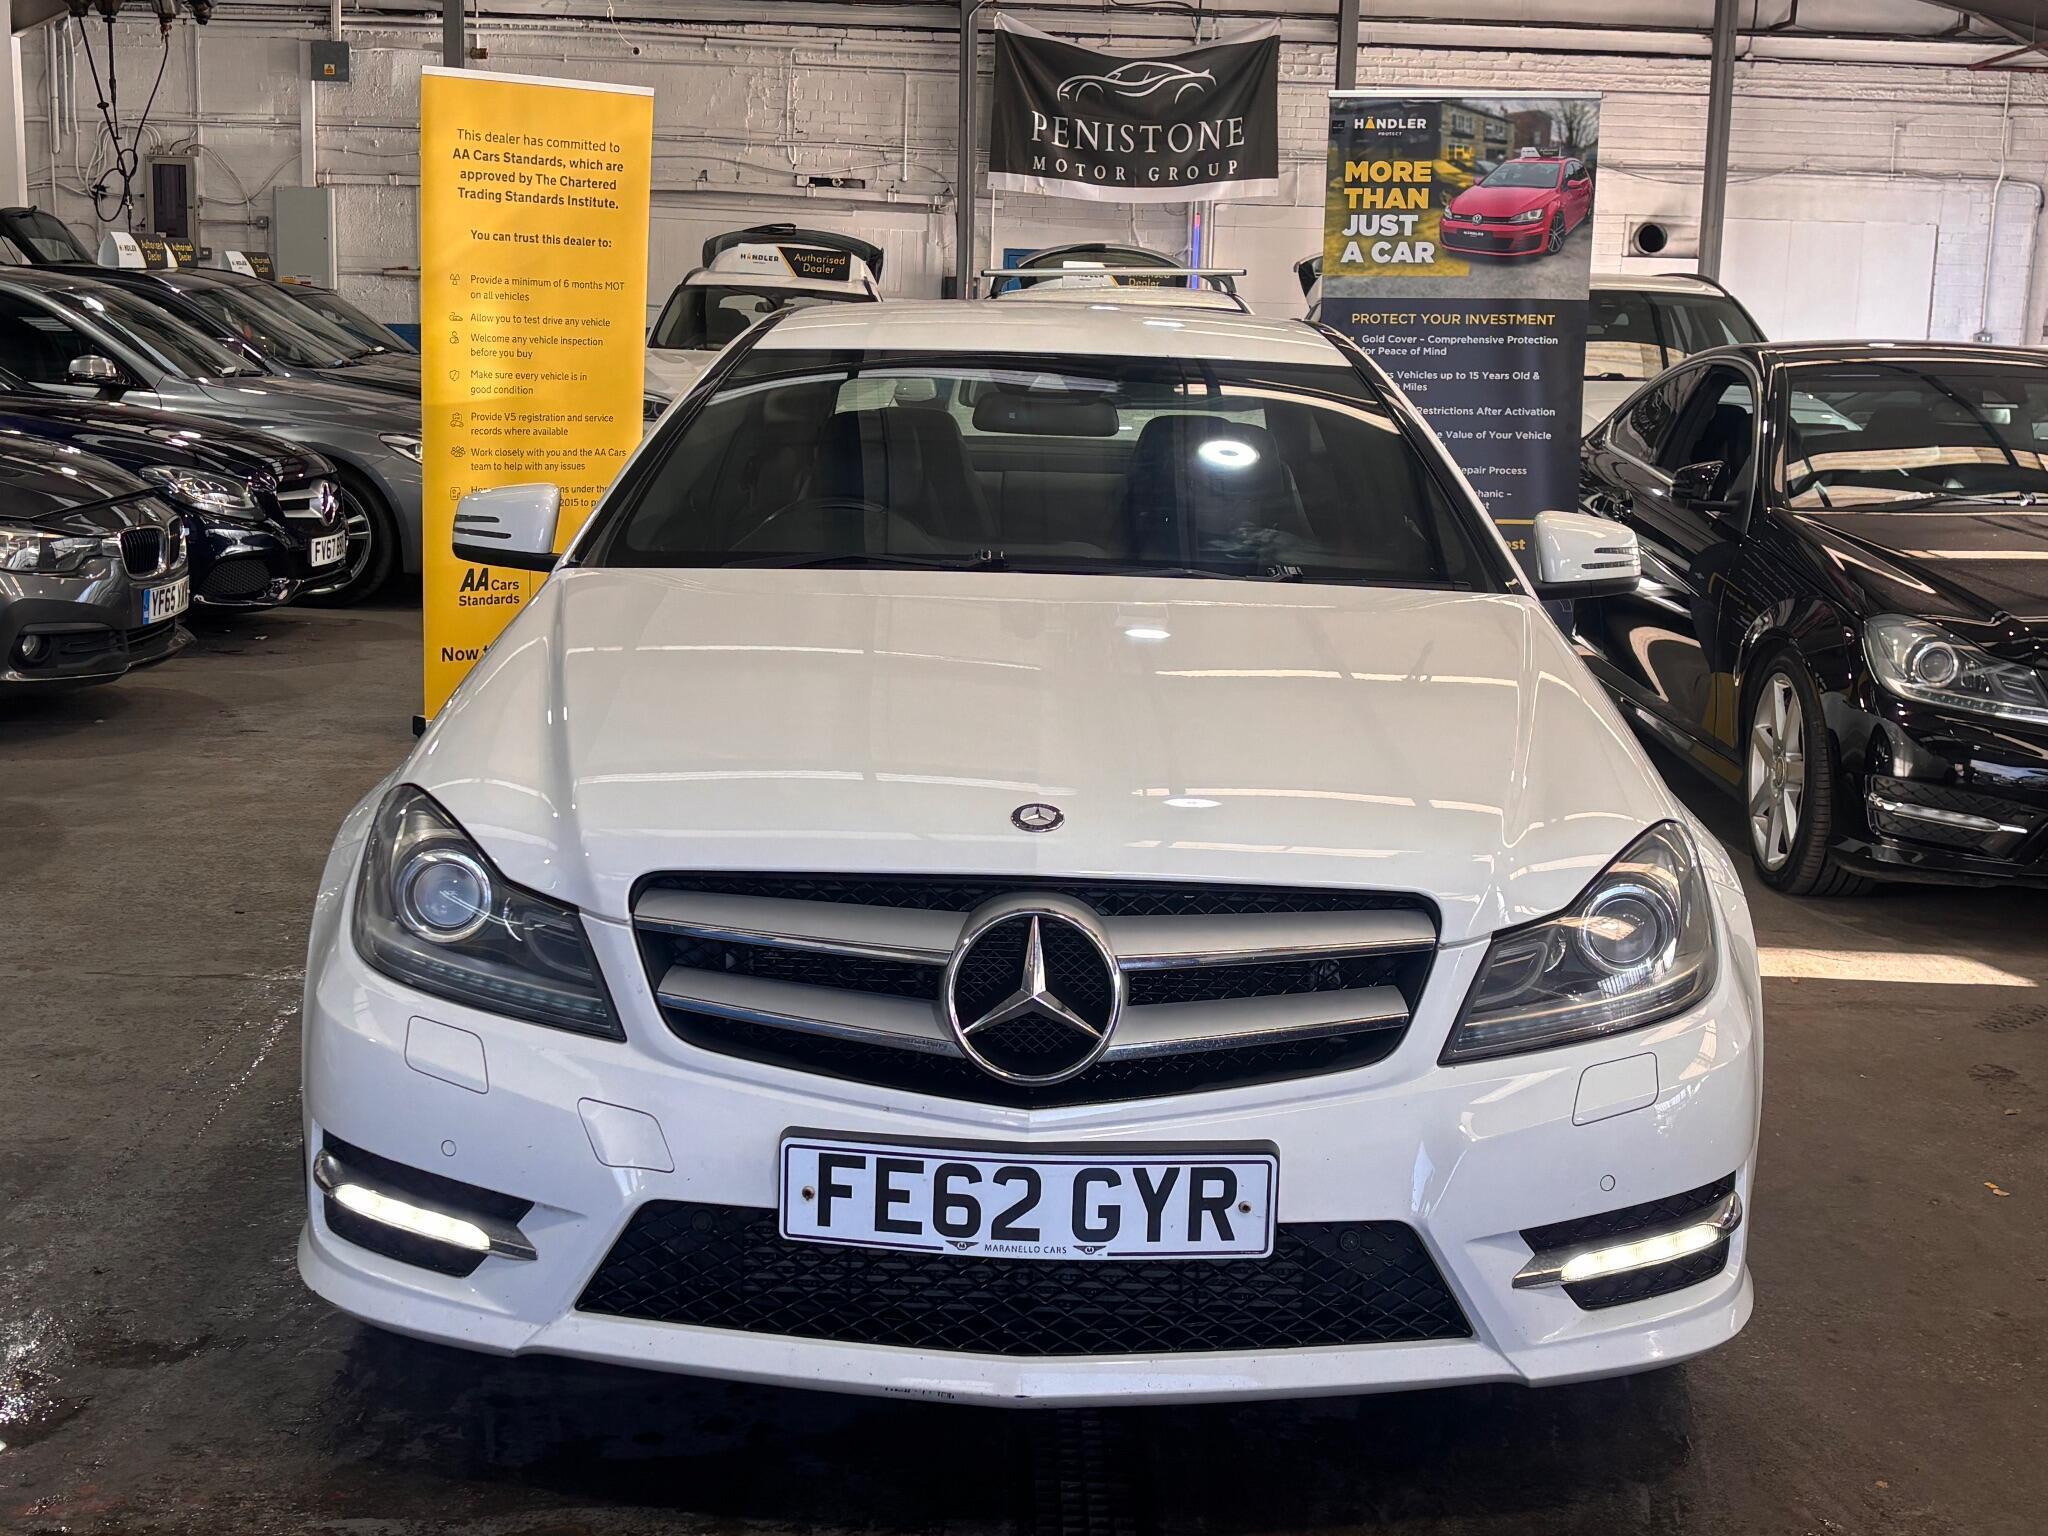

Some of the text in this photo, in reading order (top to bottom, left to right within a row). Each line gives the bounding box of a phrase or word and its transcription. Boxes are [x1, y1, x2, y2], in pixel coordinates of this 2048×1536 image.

[1032, 111, 1245, 153] PENISTONE
[457, 129, 620, 152] This dealer has committed to
[453, 148, 623, 172] AA Cars Standards, which are
[1033, 156, 1238, 182] MOTOR GROUP
[1344, 161, 1432, 182] MORE
[460, 169, 616, 190] approved by The Chartered
[458, 188, 618, 209] Trading Standards Institute.
[1344, 188, 1430, 209] THAN
[1342, 215, 1418, 236] JUST
[471, 230, 612, 248] You can trust this dealer to:
[794, 253, 846, 265] Authorised
[1340, 242, 1435, 264] A CAR
[803, 264, 835, 274] Dealer
[471, 275, 502, 285] Provide
[512, 278, 551, 287] minimum
[554, 279, 561, 288] of
[572, 281, 602, 289] months
[605, 282, 624, 290] MOT
[484, 291, 493, 300] all
[495, 292, 529, 301] vehicles
[471, 314, 494, 322] Allow
[496, 316, 511, 325] you
[524, 316, 540, 324] test
[543, 316, 562, 325] drive
[565, 318, 579, 327] any
[581, 318, 610, 326] vehicle
[1352, 314, 1555, 326] PROTECT YOUR INVESTMENT
[471, 334, 603, 347] Welcome any vehicle inspection
[1362, 335, 1385, 344] Gold
[1388, 335, 1417, 344] Cover
[1428, 335, 1504, 345] Comprehensive
[1507, 336, 1558, 345] Protection
[471, 348, 533, 359] before you buy
[1361, 346, 1447, 356] for Peace of Mind
[471, 370, 492, 379] Make
[515, 373, 538, 382] every
[540, 372, 569, 381] vehicle
[571, 372, 578, 380] is
[580, 372, 587, 381] in
[1397, 371, 1437, 380] Vehicles
[1440, 373, 1453, 381] up
[1456, 372, 1465, 380] to
[1469, 372, 1479, 380] 15
[1482, 372, 1509, 380] Years
[1513, 372, 1530, 380] Old
[1532, 372, 1540, 380] &
[471, 386, 533, 395] good condition
[1403, 383, 1427, 391] Miles
[1416, 406, 1555, 416] Restrictions After Activation
[471, 413, 502, 421] Provide
[519, 413, 565, 423] registration
[471, 427, 568, 436] records where available
[1446, 431, 1473, 439] Value
[1476, 431, 1486, 439] of
[1489, 431, 1512, 439] Your
[1516, 431, 1552, 440] Vehicle
[471, 448, 492, 456] Work
[495, 448, 524, 458] closely
[527, 448, 544, 456] with
[562, 448, 577, 456] and
[608, 448, 626, 456] Cars
[504, 463, 522, 472] help
[525, 463, 542, 471] with
[545, 464, 558, 472] any
[561, 463, 585, 471] issues
[1462, 467, 1527, 475] epair Process
[571, 485, 594, 493] under
[460, 568, 519, 592] AA Cars
[152, 586, 175, 616] YF65
[459, 594, 520, 606] Standards
[442, 648, 478, 662] Now
[817, 1152, 1238, 1244] FE62 GYR
[985, 1244, 1067, 1254] MARANELLO CARS
